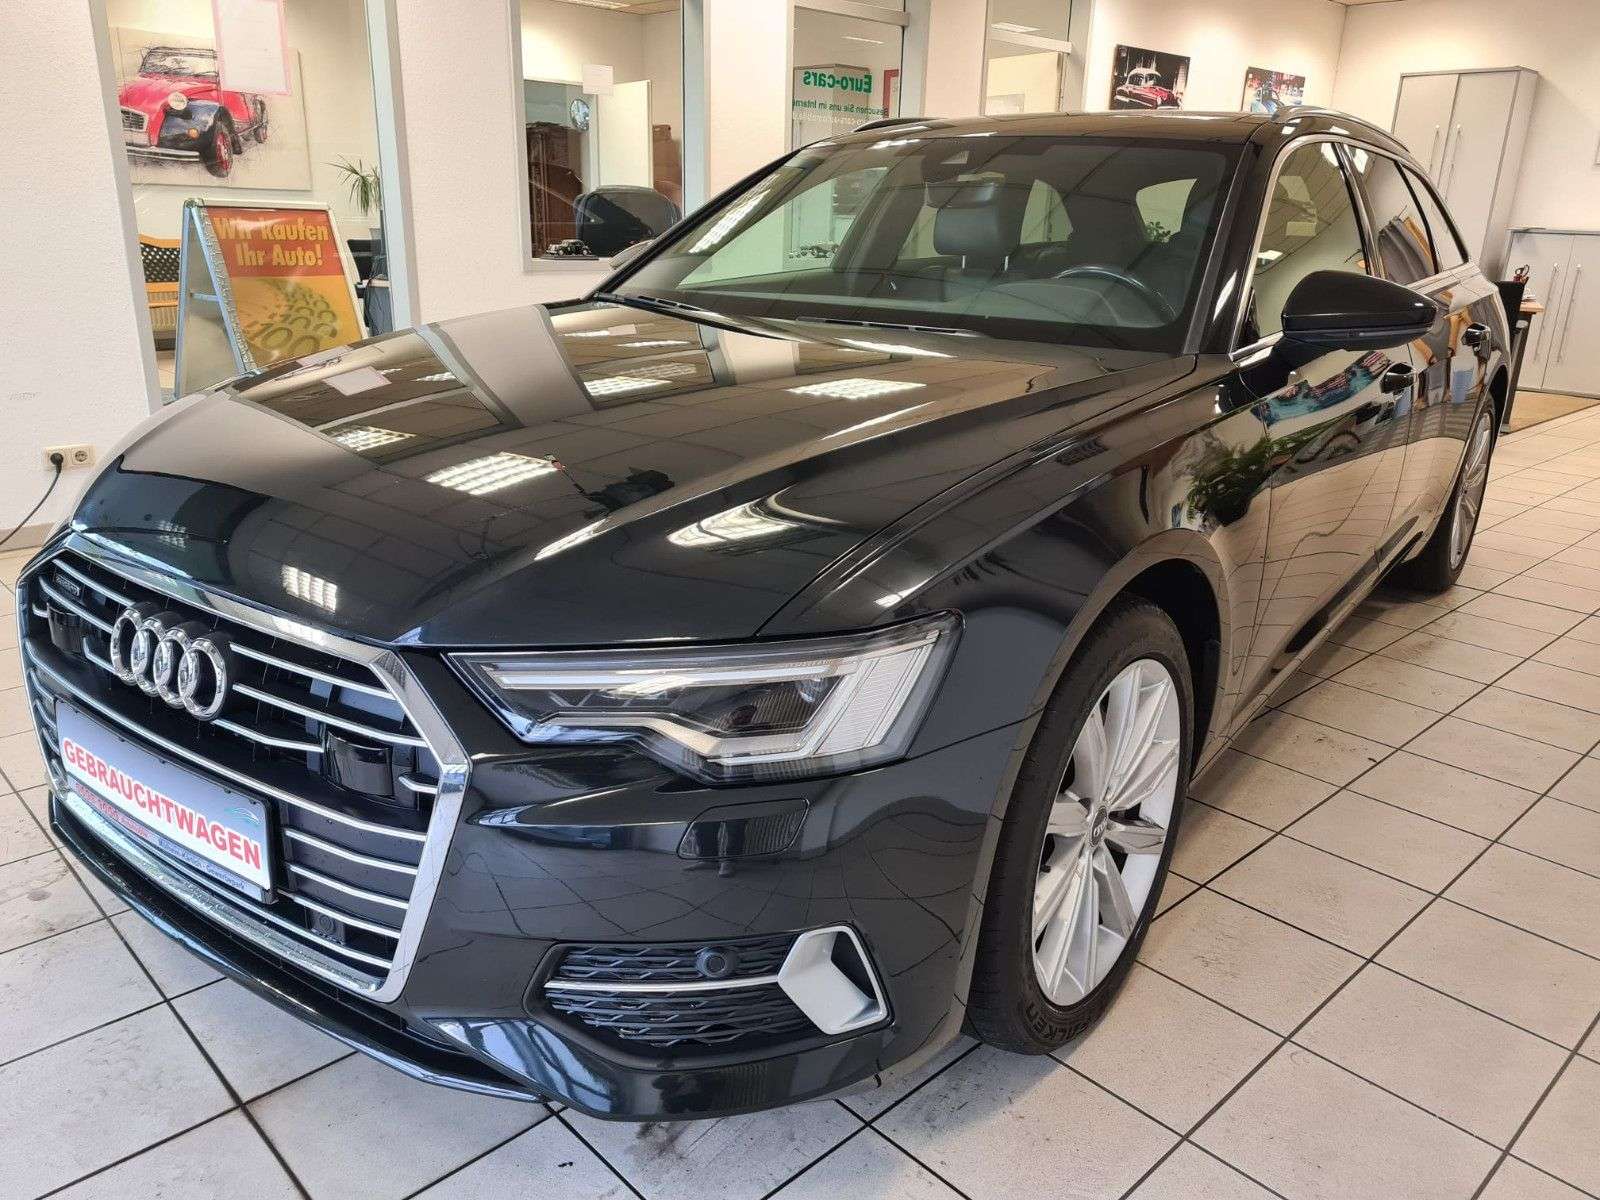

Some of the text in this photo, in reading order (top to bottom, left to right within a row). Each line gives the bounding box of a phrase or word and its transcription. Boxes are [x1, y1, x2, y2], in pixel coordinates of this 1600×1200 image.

[213, 217, 328, 240] Wir kaufen
[235, 241, 323, 267] Ihr Auto!
[63, 740, 261, 870] GEBRAUCHTWAGEN
